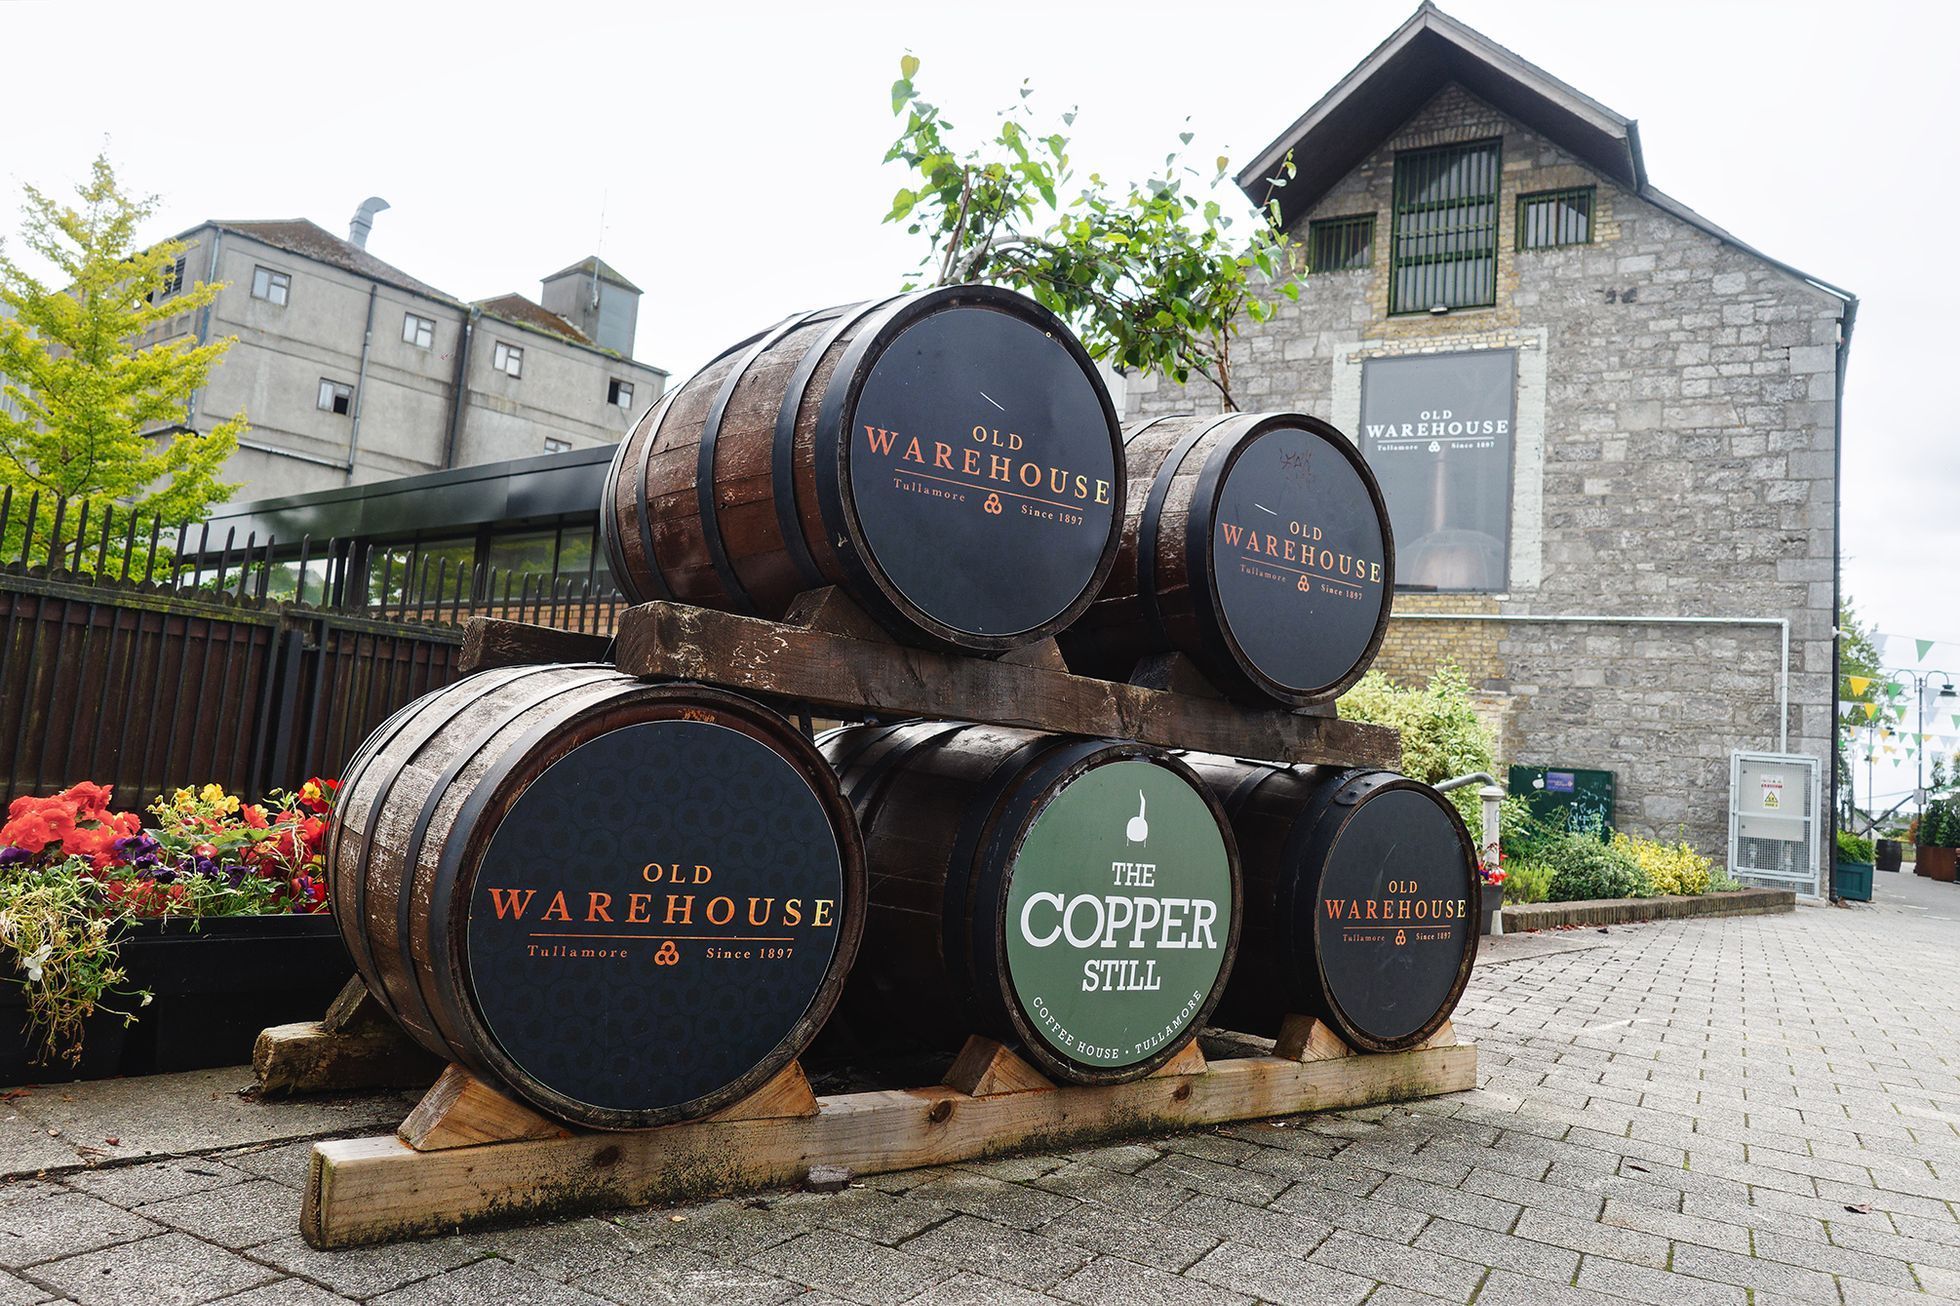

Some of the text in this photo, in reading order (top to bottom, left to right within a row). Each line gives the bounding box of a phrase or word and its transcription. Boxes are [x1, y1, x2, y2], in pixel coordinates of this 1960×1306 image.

[1420, 410, 1452, 420] OLD
[972, 425, 1023, 450] OLD
[1366, 420, 1509, 438] WAREHOUSE
[864, 425, 1111, 505] WAREHOUSE
[894, 478, 1084, 526] Tullamore Since 1897
[1290, 521, 1322, 541] OLD
[1222, 523, 1381, 583] WAREHOUSE
[1240, 564, 1363, 600] Tullamore Since 1897
[642, 863, 713, 885] OLD
[1111, 862, 1156, 887] THE
[1388, 880, 1418, 894] OLD
[488, 887, 835, 927] WAREHOUSE
[1325, 899, 1467, 919] WAREHOUSE
[1020, 891, 1218, 949] COPPER
[1342, 934, 1385, 942] Tullamore
[1416, 932, 1435, 940] Since
[527, 944, 794, 960] Tullamore Since 1897
[1082, 959, 1161, 992] STILL
[1033, 990, 1202, 1060] COFFEE HOUSE TULLAMORE
